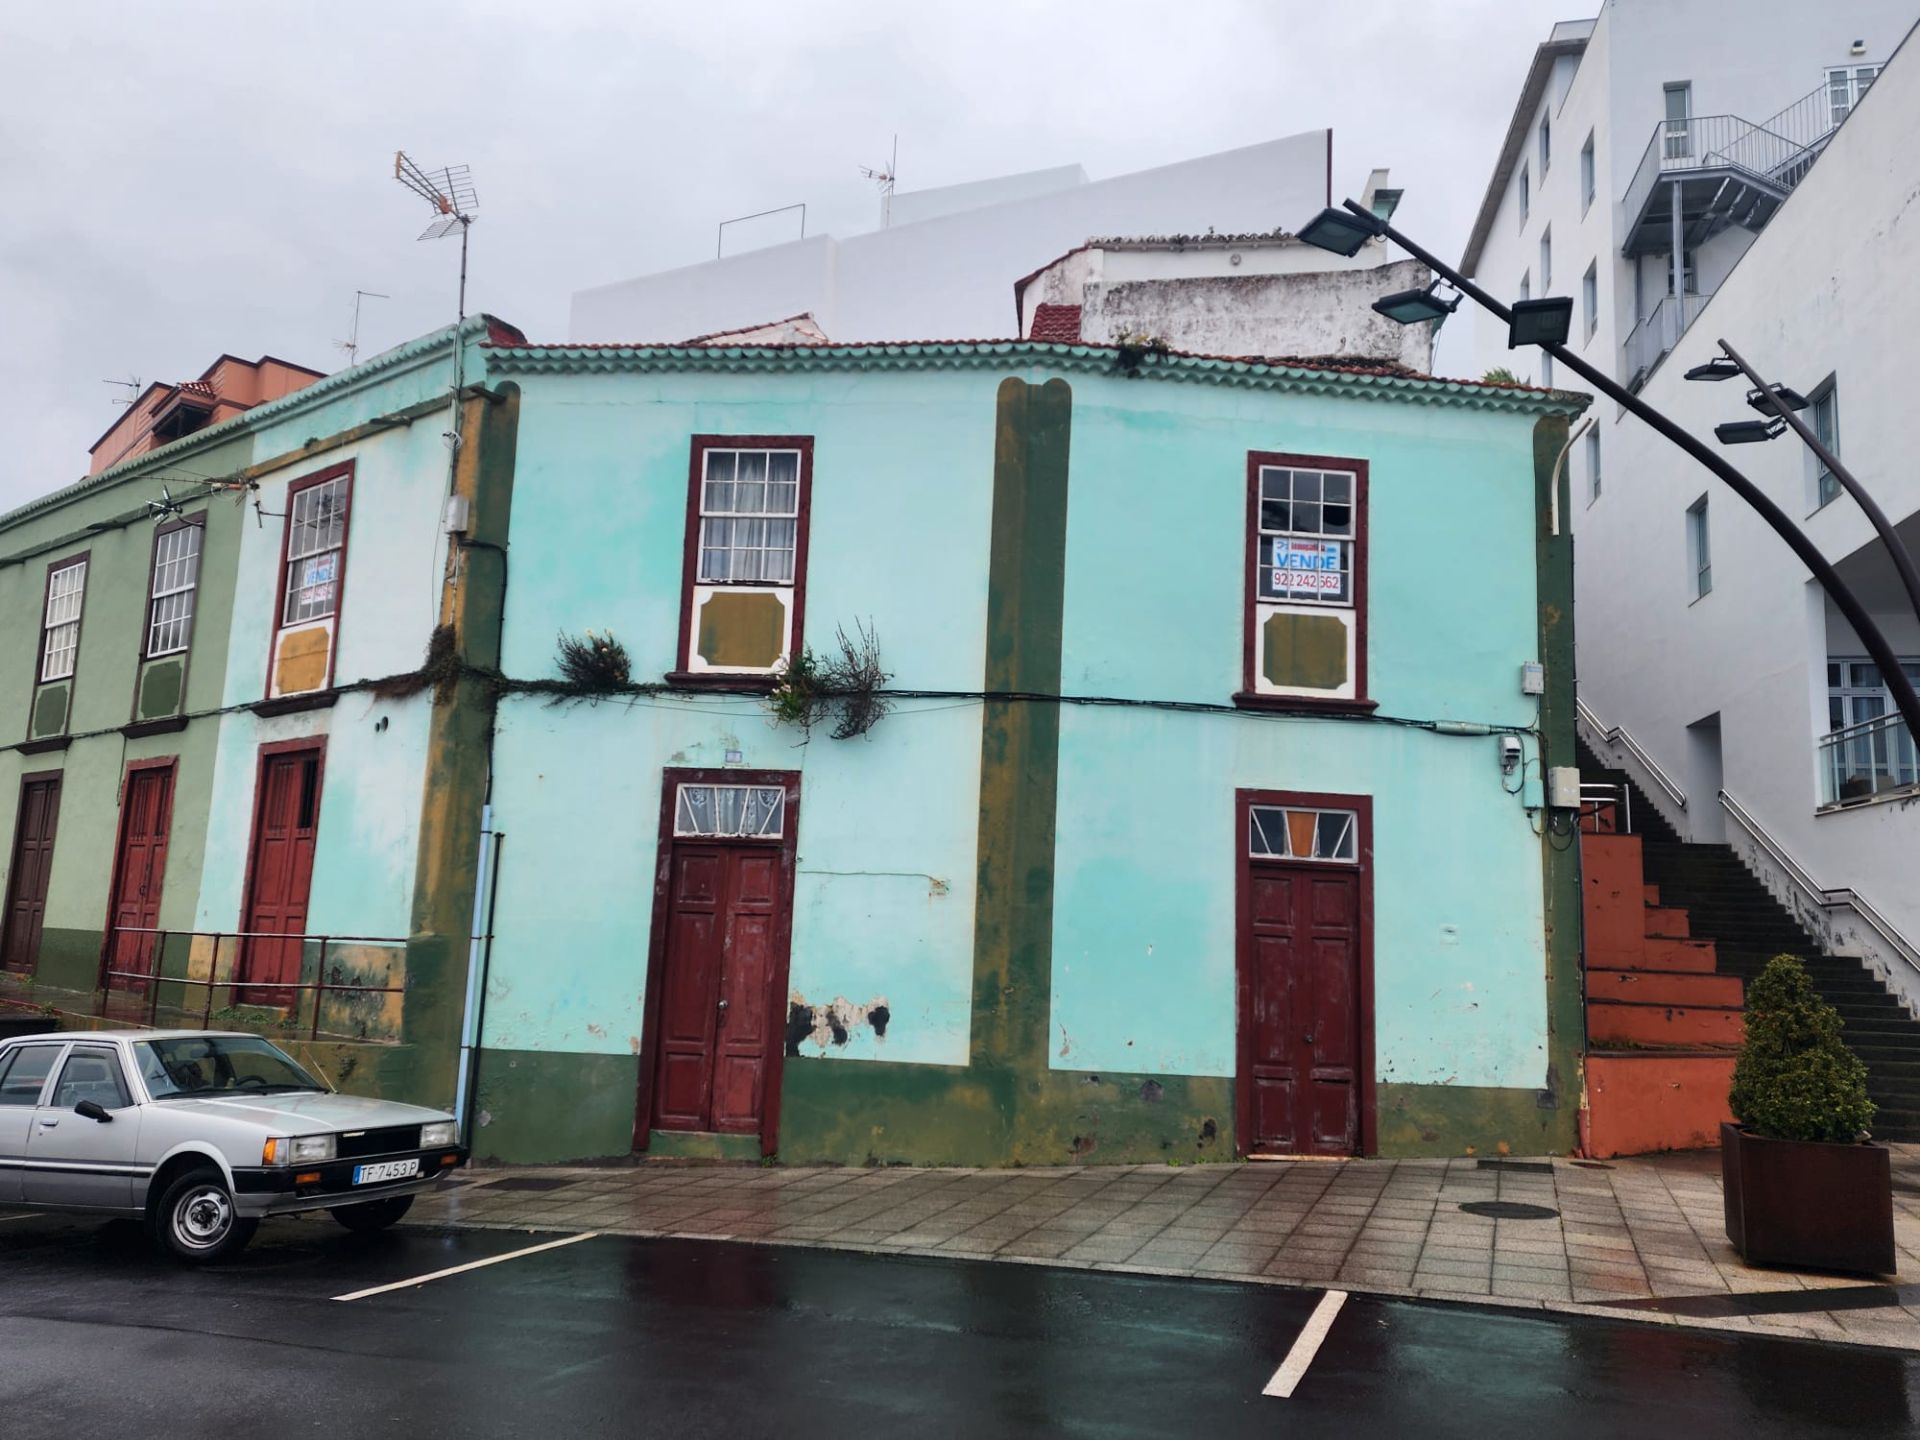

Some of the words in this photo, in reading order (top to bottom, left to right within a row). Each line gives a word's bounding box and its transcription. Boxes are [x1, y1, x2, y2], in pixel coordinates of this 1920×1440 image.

[1276, 553, 1337, 570] VENDE
[1274, 572, 1295, 587] 922
[1296, 574, 1317, 588] 242
